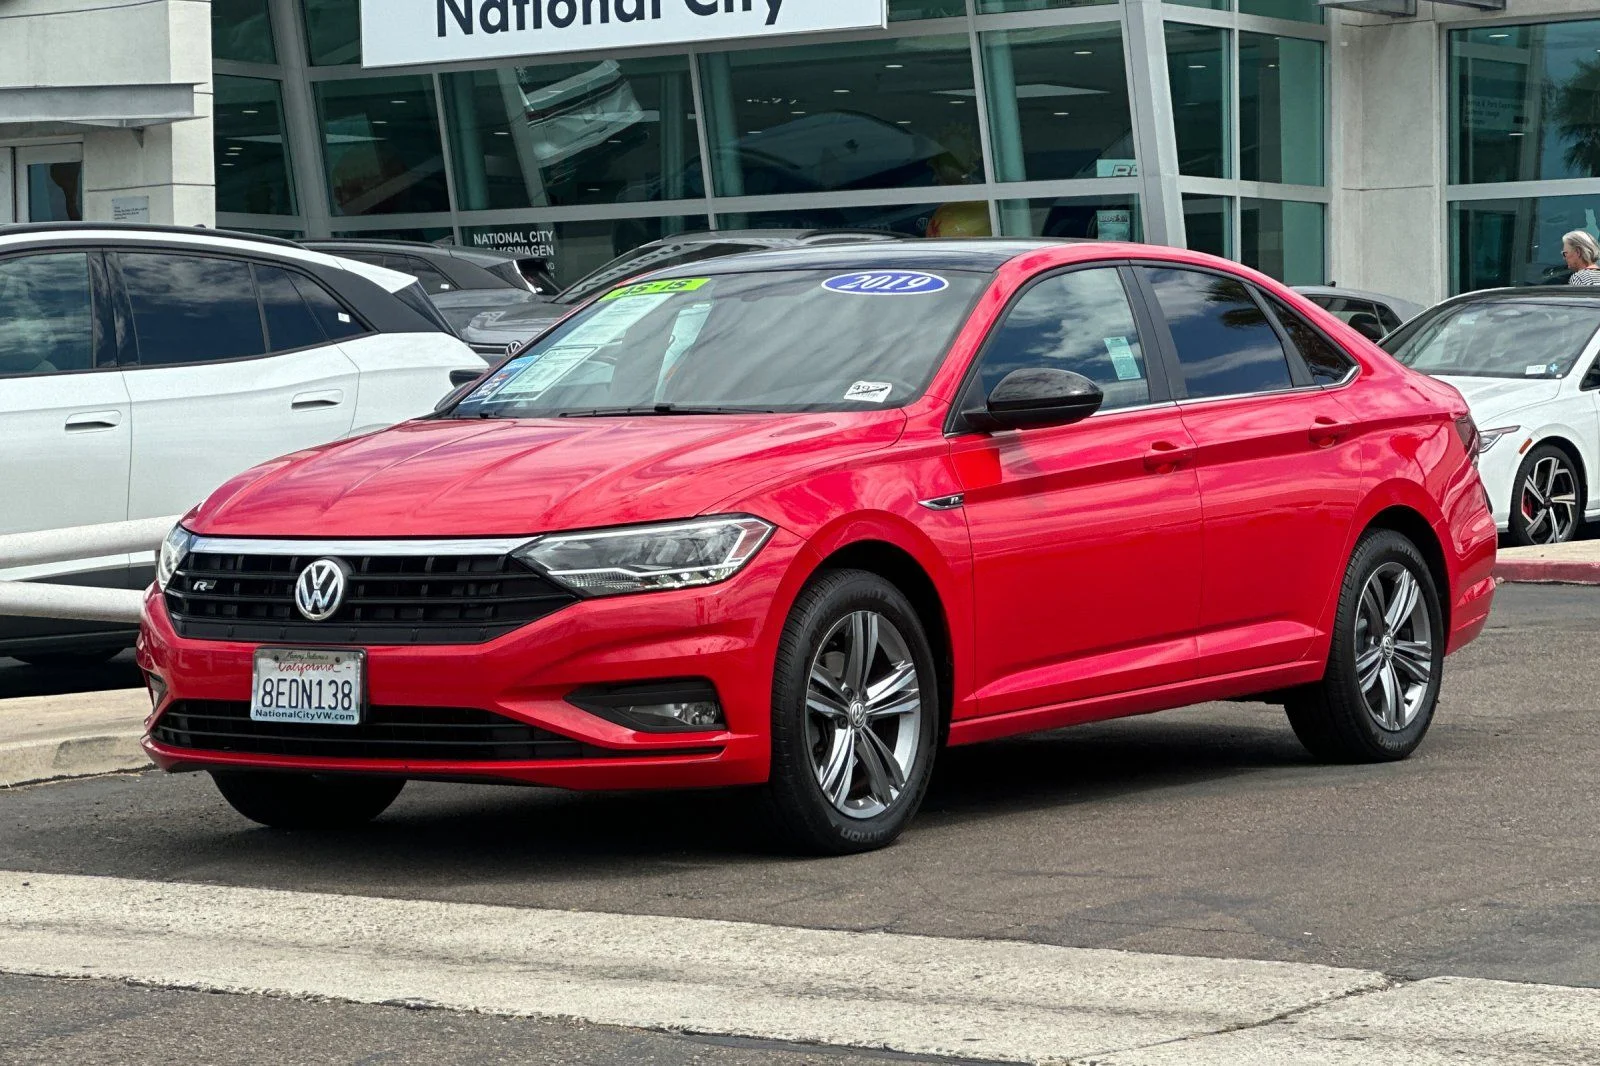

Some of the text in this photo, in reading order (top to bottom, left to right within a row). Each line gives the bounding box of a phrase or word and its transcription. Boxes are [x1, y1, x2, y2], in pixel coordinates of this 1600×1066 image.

[473, 230, 554, 245] NATIONAL CITY
[837, 275, 931, 290] 2019
[296, 559, 345, 621] VW
[278, 661, 342, 677] California
[255, 709, 355, 721] NationalCityVW.com
